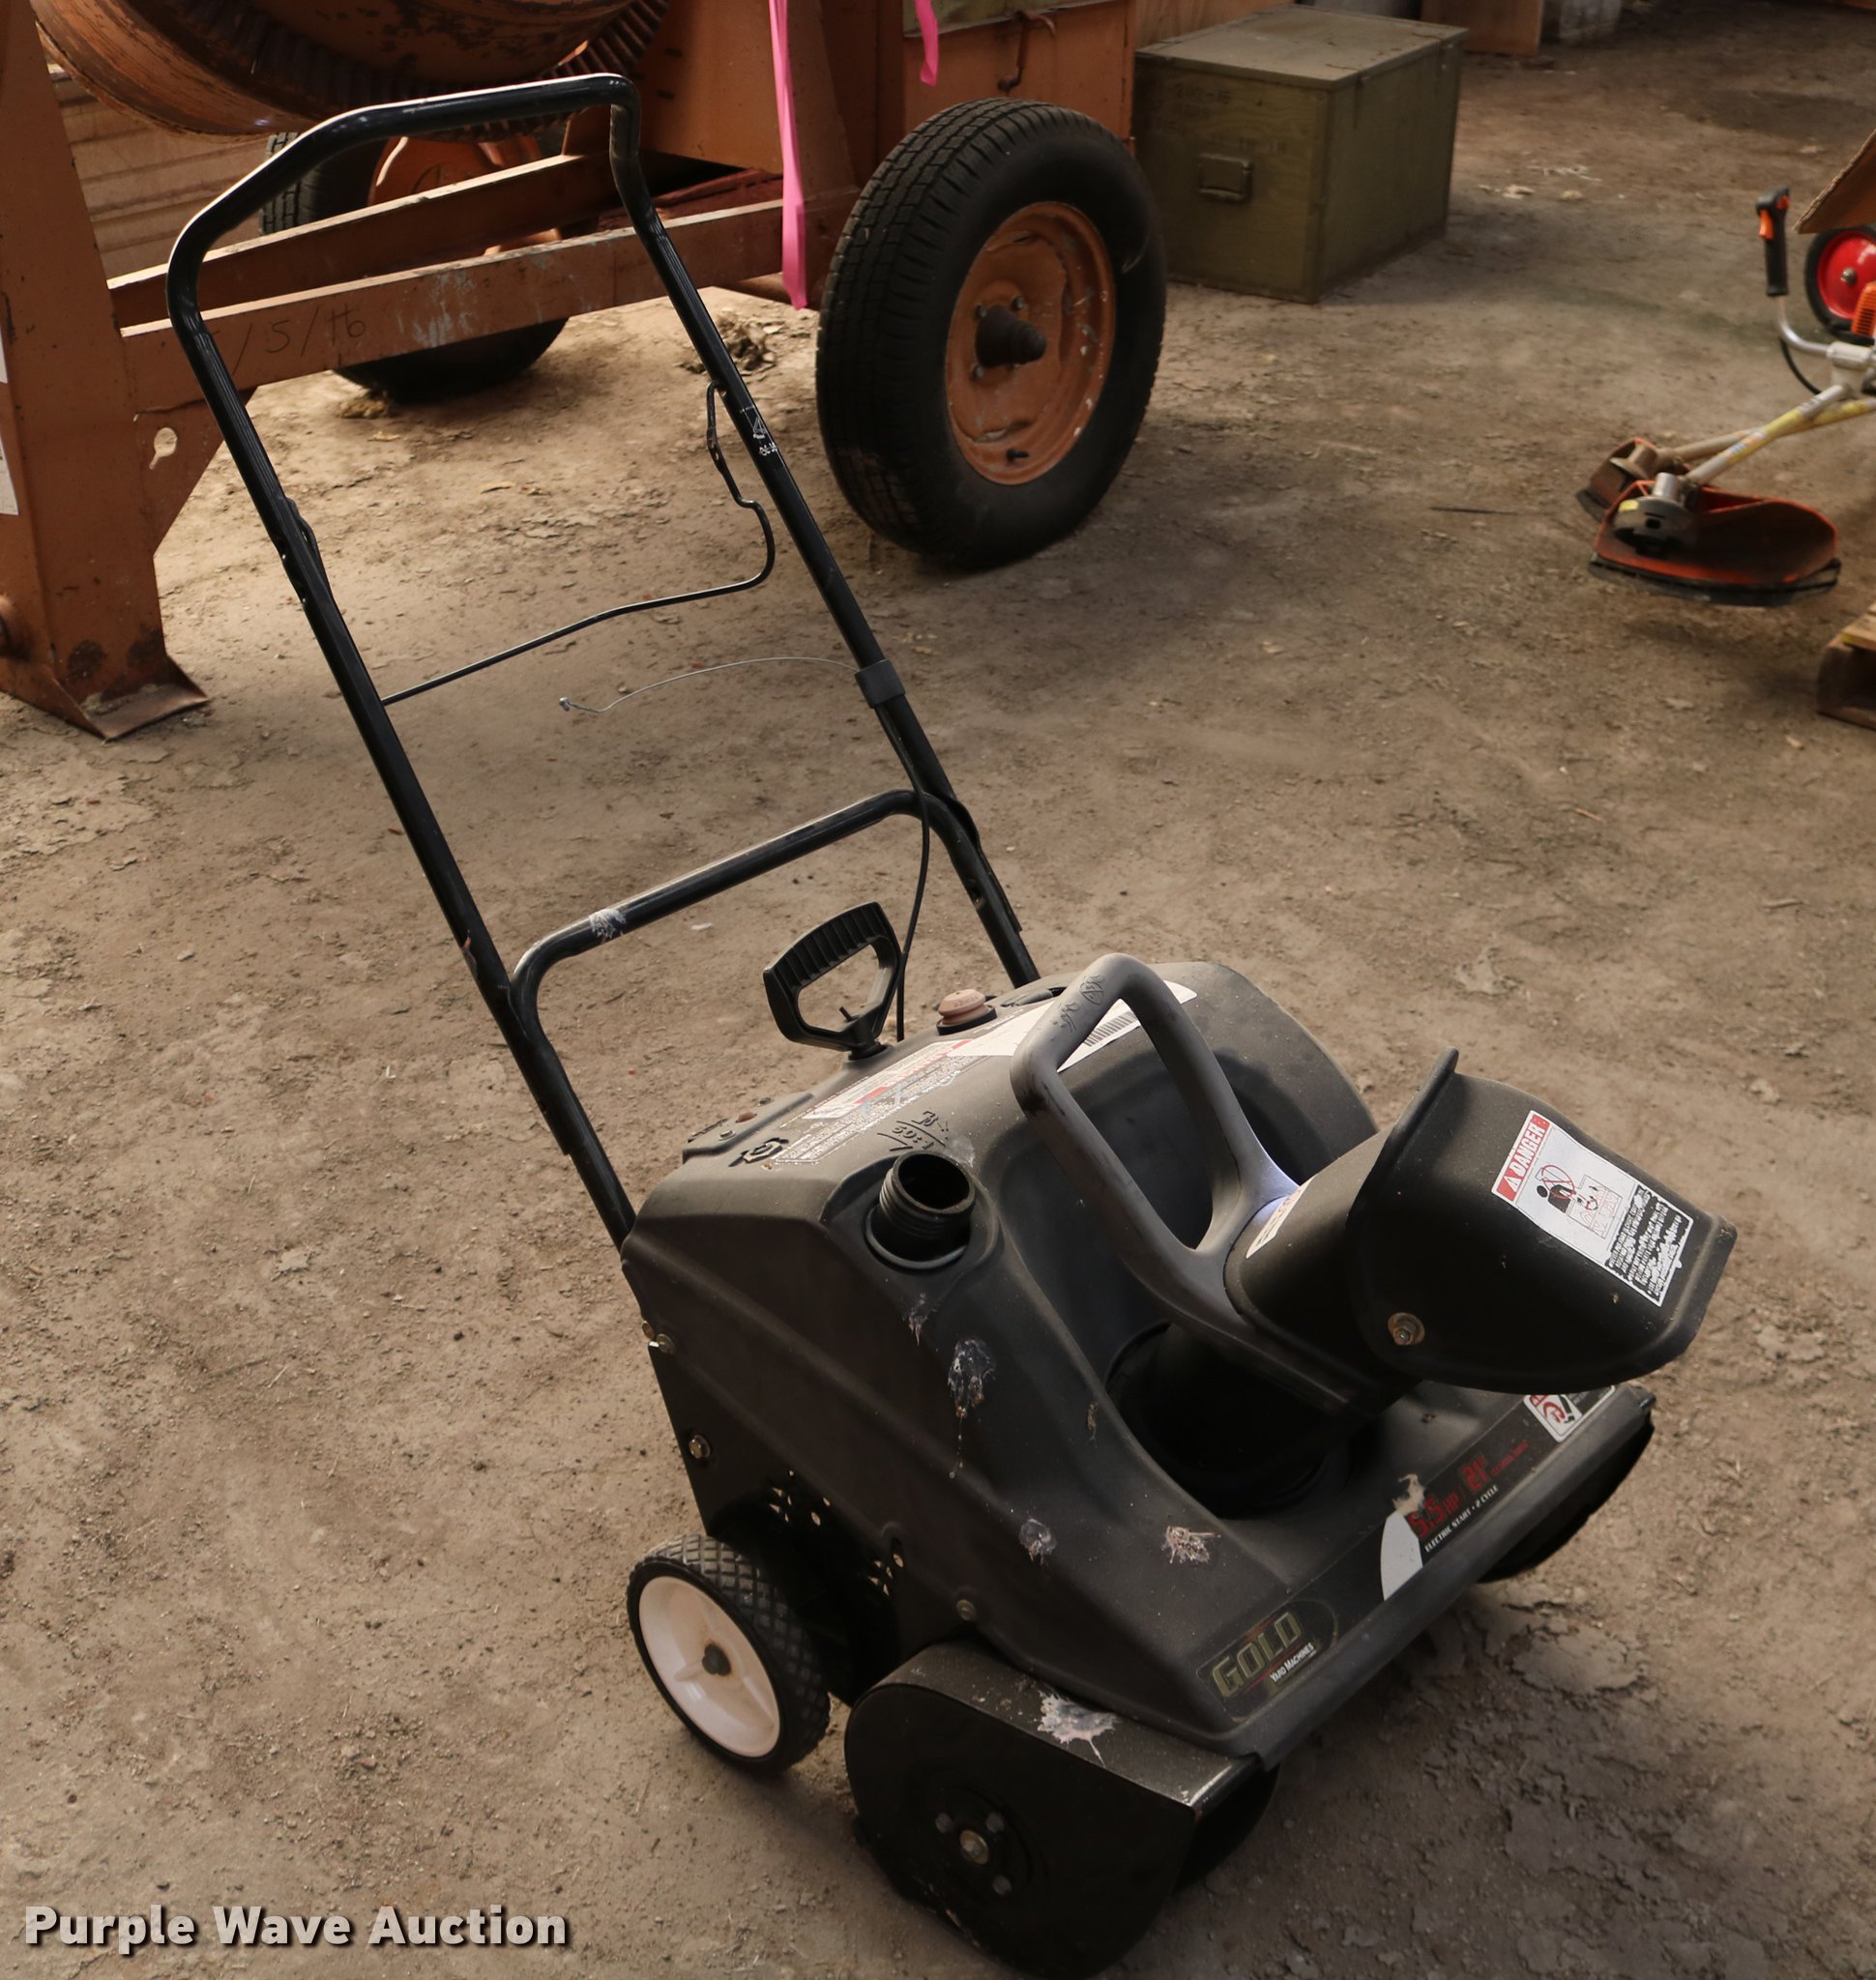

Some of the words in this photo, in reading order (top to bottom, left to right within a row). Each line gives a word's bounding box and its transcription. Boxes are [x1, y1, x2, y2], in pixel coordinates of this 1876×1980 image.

[1509, 1122, 1546, 1178] DANGER
[1406, 1495, 1448, 1538] 5.5
[1444, 1492, 1460, 1514] HP
[1424, 1528, 1453, 1553] ELECTRIC
[1451, 1506, 1473, 1529] START
[1480, 1484, 1499, 1503] CYCLE
[1212, 1612, 1303, 1698] GOLD
[1270, 1667, 1287, 1682] YARD
[1283, 1642, 1315, 1671] MACHINES
